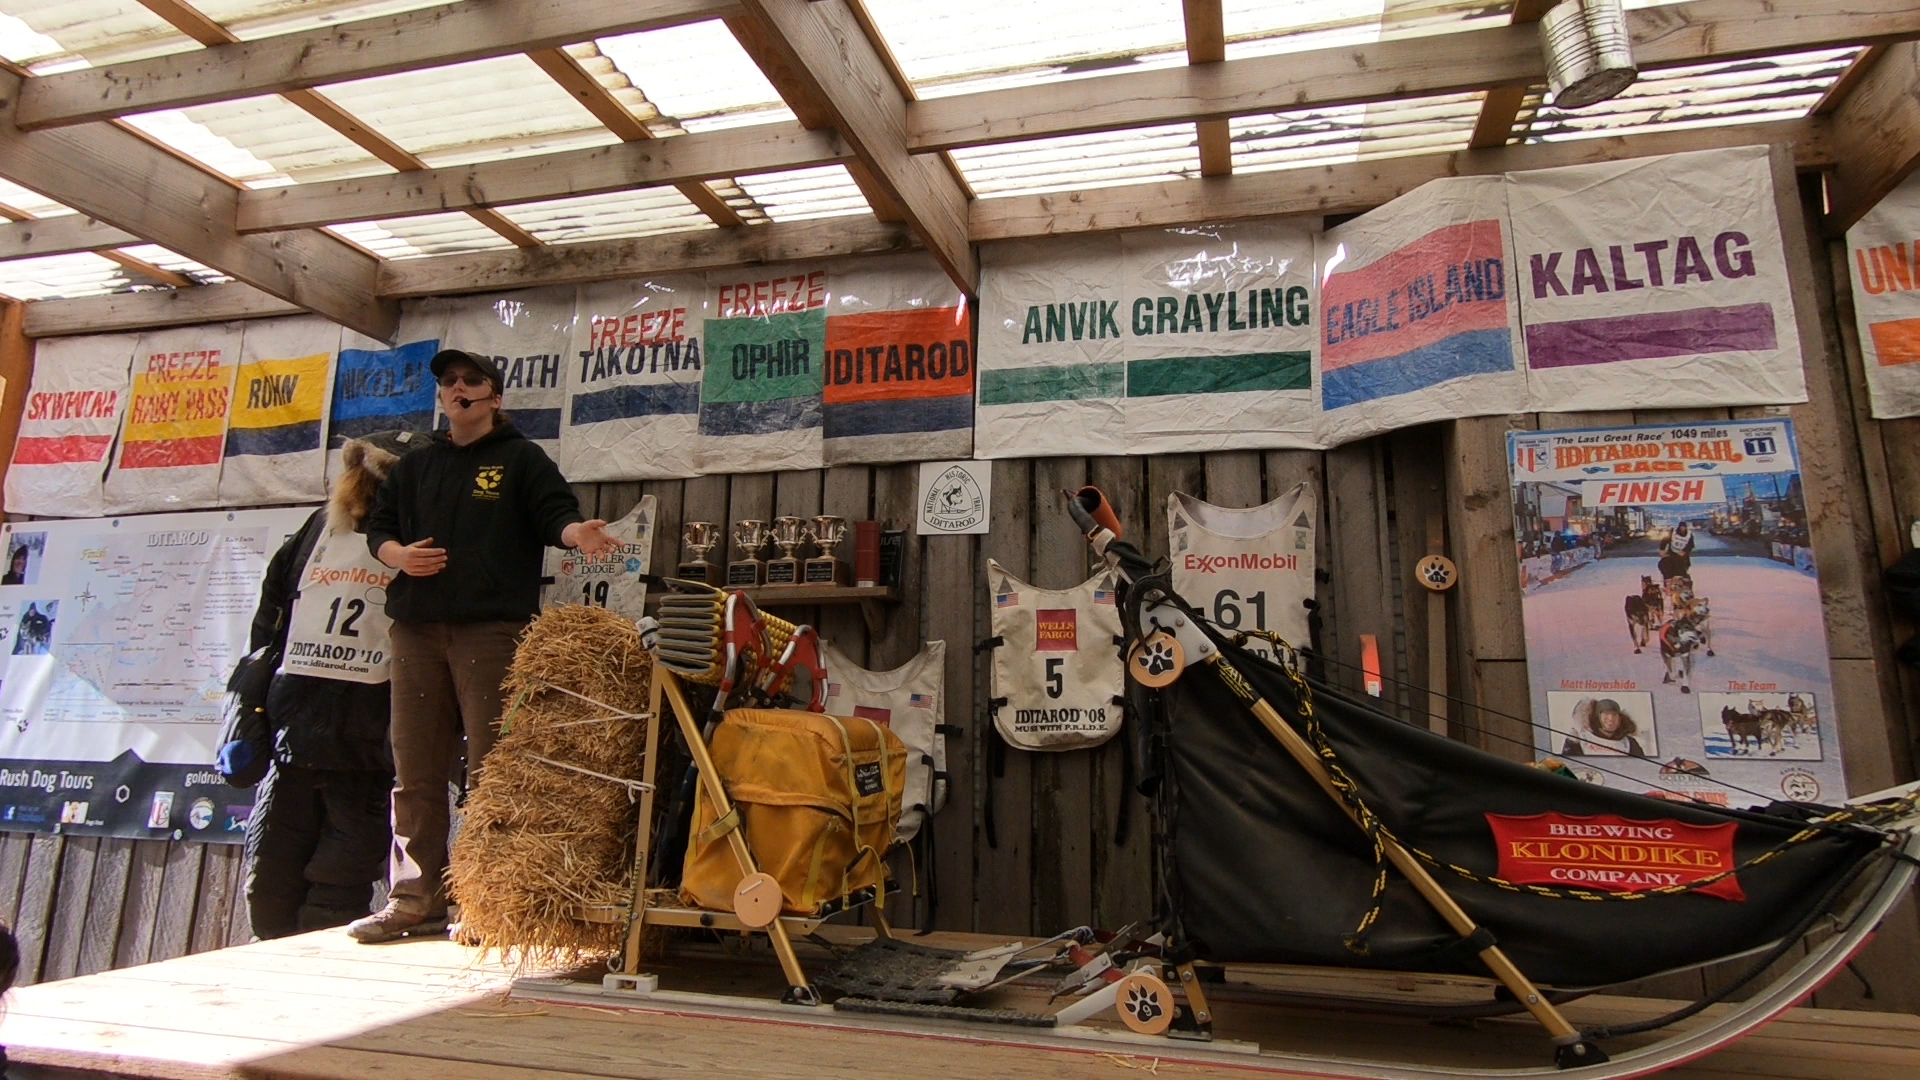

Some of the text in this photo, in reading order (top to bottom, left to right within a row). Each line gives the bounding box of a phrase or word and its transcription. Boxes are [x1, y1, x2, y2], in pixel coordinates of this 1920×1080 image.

[1529, 231, 1757, 300] KALTAG
[1855, 240, 1920, 295] UN
[717, 271, 826, 318] FREEZE
[1327, 258, 1506, 345] EAGLE ISLAND
[1022, 299, 1121, 345] ANVIK
[1132, 286, 1310, 336] GRAYLING
[590, 307, 687, 349] FREEZE
[146, 350, 221, 384] FREEZE
[579, 336, 701, 383] TAKOTNA
[732, 338, 810, 381] OPHIR
[825, 339, 970, 387] IDITAROD
[247, 373, 299, 410] ROHN
[342, 361, 424, 400] NIKOLAI
[28, 390, 118, 421] SKWENTNA
[185, 386, 229, 421] PASS
[1578, 435, 1600, 443] Last
[1604, 433, 1632, 442] Great
[1671, 428, 1698, 439] 1049
[1701, 427, 1728, 438] miles
[1746, 438, 1776, 454] 11
[1553, 439, 1743, 470] IDITAROD TRAIL
[944, 470, 971, 485] HISTORIC
[1613, 460, 1685, 474] RACE
[926, 487, 940, 514] NATIONAL
[1599, 479, 1704, 504] FINISH
[973, 496, 982, 513] TRAIL
[929, 516, 976, 529] IDITAROD
[147, 531, 210, 548] IDITAROD
[575, 554, 625, 565] CHYLER
[581, 564, 616, 574] DODGE
[1184, 553, 1297, 573] ExxonMobil
[310, 567, 392, 587] ExxonMob
[582, 580, 610, 608] 19
[325, 597, 366, 638] 12
[1214, 589, 1265, 631] 61
[1038, 621, 1075, 631] WELLS
[1039, 630, 1075, 640] FARGO
[289, 642, 384, 665] IDITAROD '10
[291, 659, 370, 674] www.iditarod.com
[1045, 658, 1064, 699] 5
[1560, 679, 1636, 692] Matt Hayashida
[1727, 680, 1776, 690] The Team
[1014, 723, 1109, 733] MUSH WITH P.R.I.D.E.
[1015, 708, 1081, 724] IDITAROD
[0, 769, 95, 793] Rush Dog Tours
[1549, 823, 1674, 840] BREWING
[1510, 841, 1723, 868] KLONDIKE
[1550, 868, 1682, 886] COMPANY
[1142, 1004, 1153, 1017] 9
